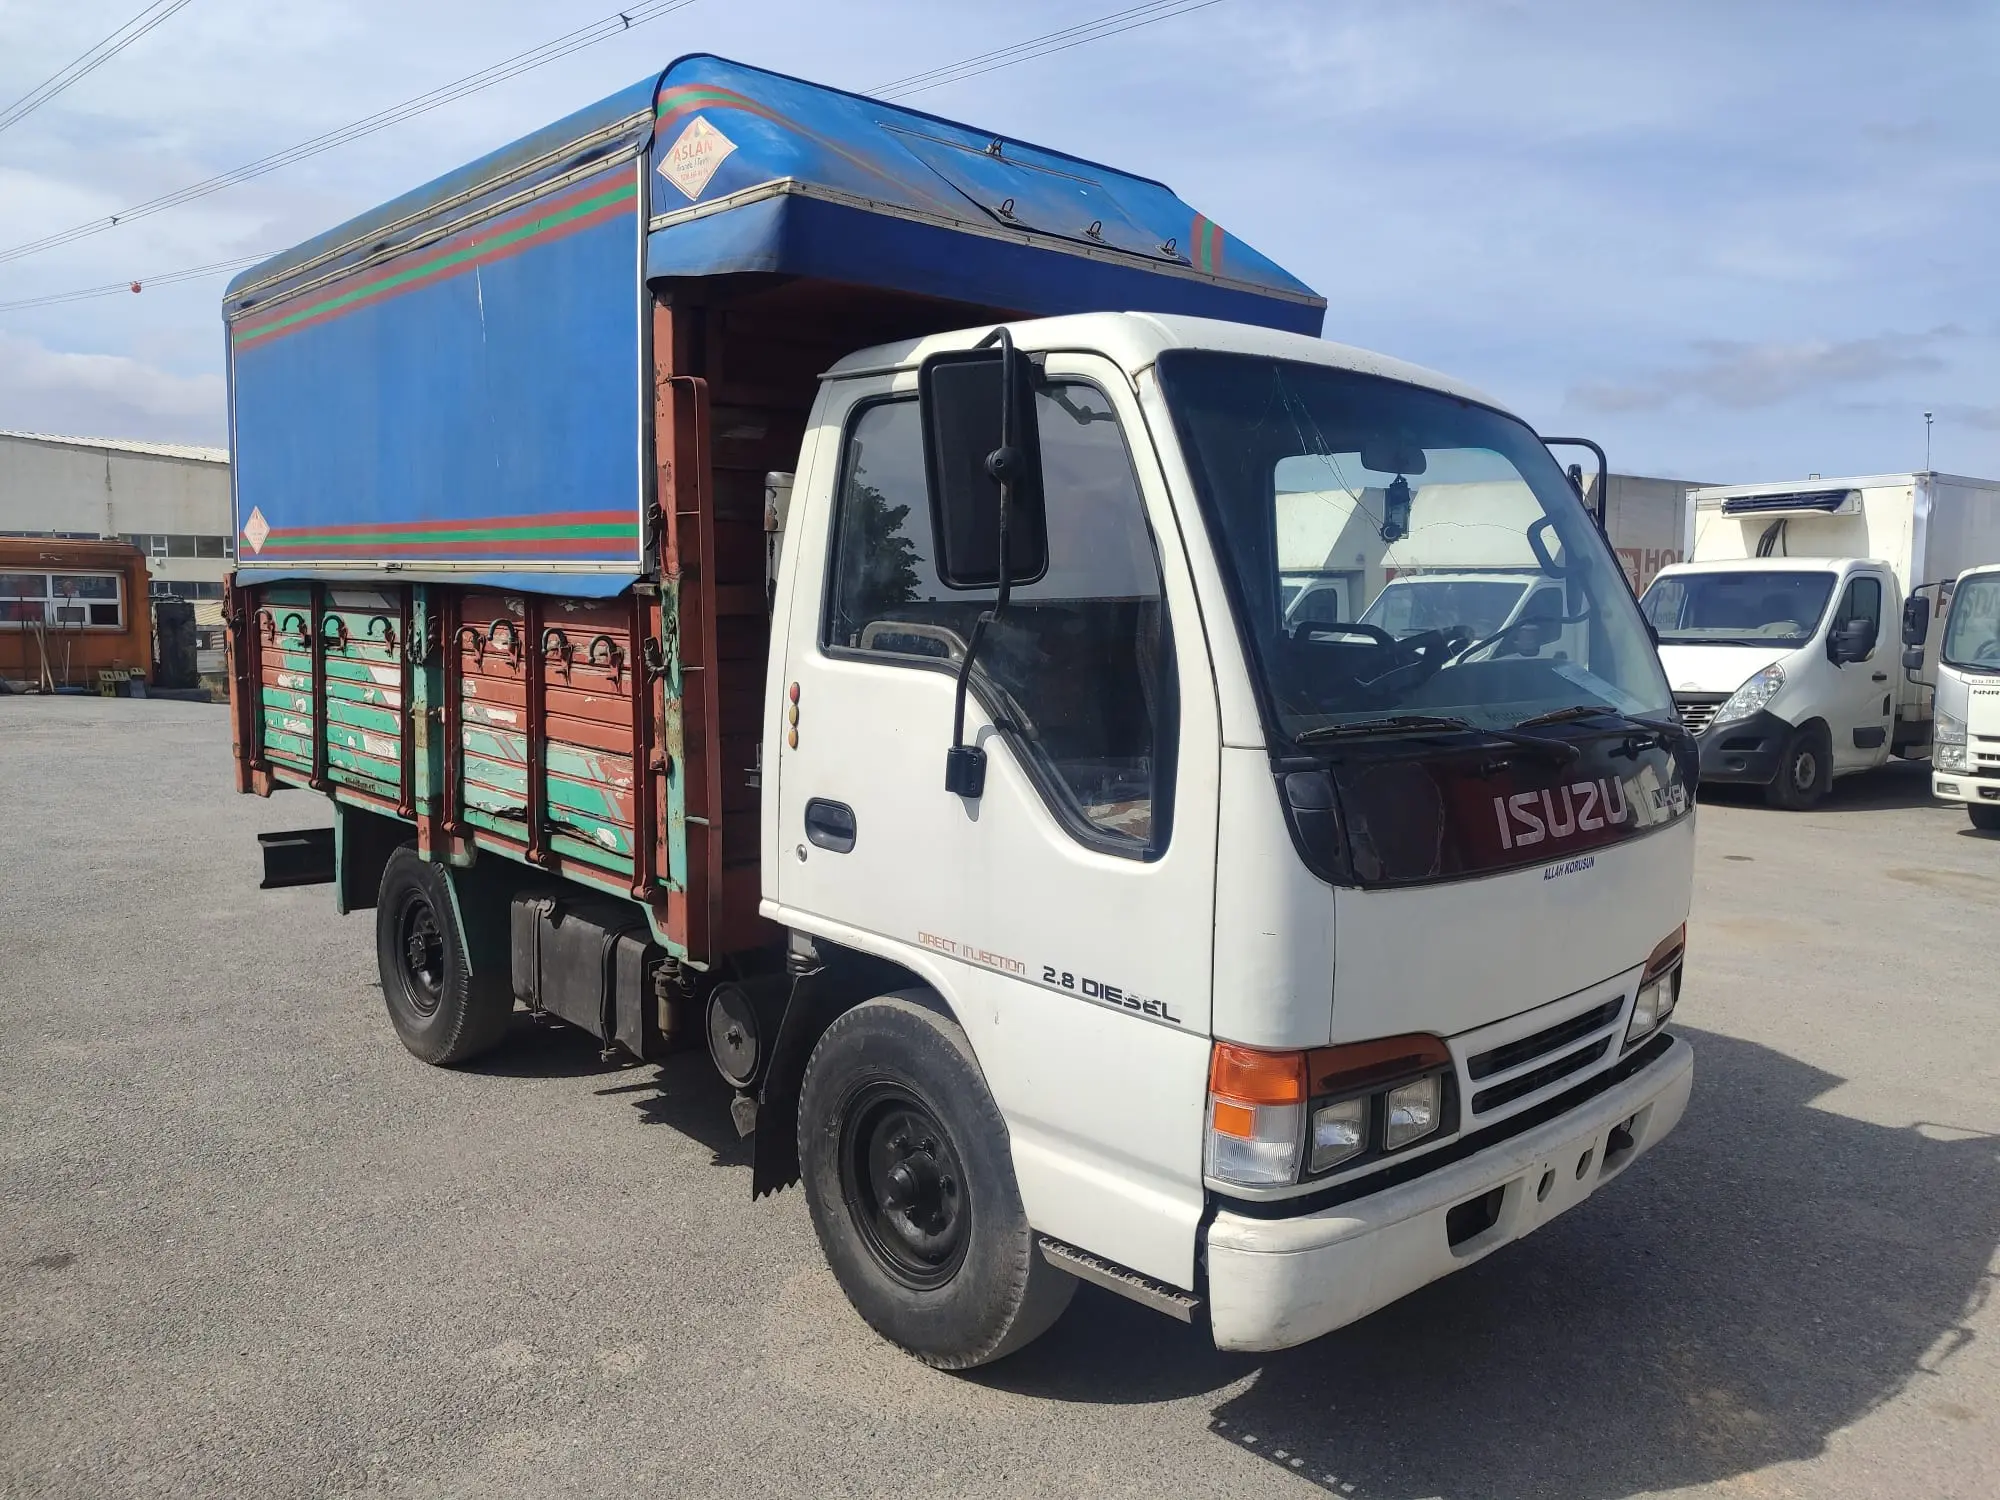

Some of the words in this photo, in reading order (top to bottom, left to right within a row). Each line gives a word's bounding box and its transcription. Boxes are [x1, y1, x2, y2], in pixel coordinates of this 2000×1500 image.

[673, 140, 713, 165] ASLAN
[1493, 775, 1628, 850] ISUZU
[1543, 864, 1564, 881] ALLAH
[1564, 856, 1595, 875] KORUSUN
[917, 930, 957, 953] DIRECT
[962, 943, 1026, 976] INJECTION
[1042, 965, 1075, 990] 2.8
[1081, 977, 1182, 1024] DIESEL
